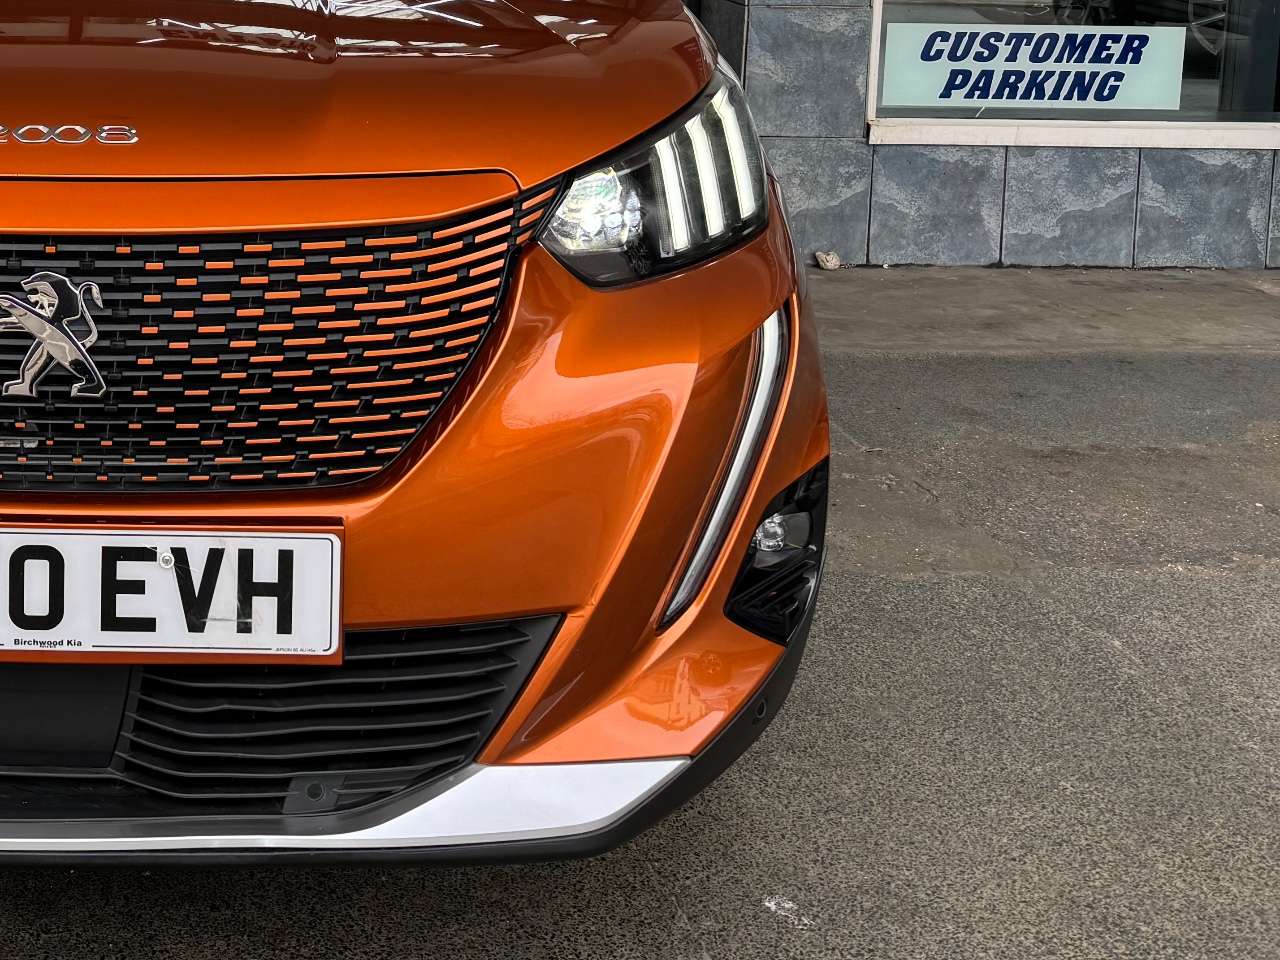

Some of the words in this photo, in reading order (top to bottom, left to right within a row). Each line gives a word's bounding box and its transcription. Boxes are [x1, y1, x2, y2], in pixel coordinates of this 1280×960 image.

[920, 31, 1150, 65] CUSTOMER
[938, 68, 1126, 102] PARKING
[100, 545, 294, 635] EVH
[13, 638, 64, 646] Birchwood
[66, 639, 82, 647] Kia
